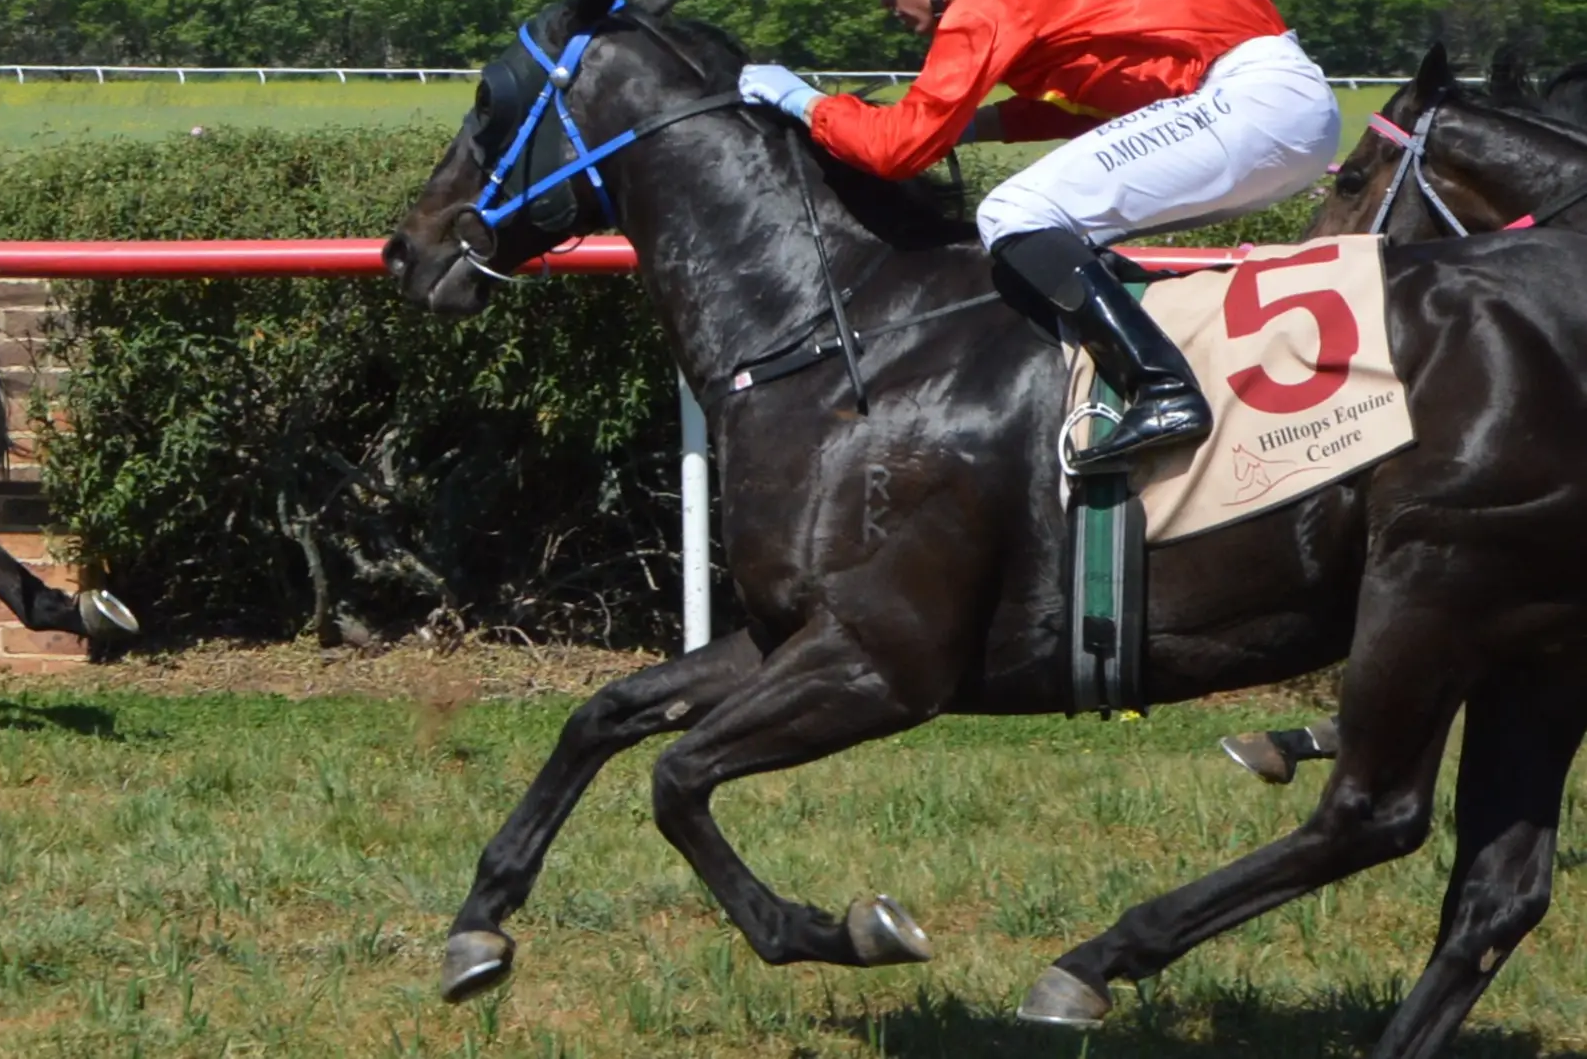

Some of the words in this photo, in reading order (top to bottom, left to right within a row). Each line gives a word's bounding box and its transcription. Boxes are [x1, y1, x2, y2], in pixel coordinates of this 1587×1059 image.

[1224, 243, 1359, 414] 5
[1258, 417, 1331, 453] Hilltops
[1333, 390, 1395, 424] Equine
[1306, 428, 1362, 463] Centre
